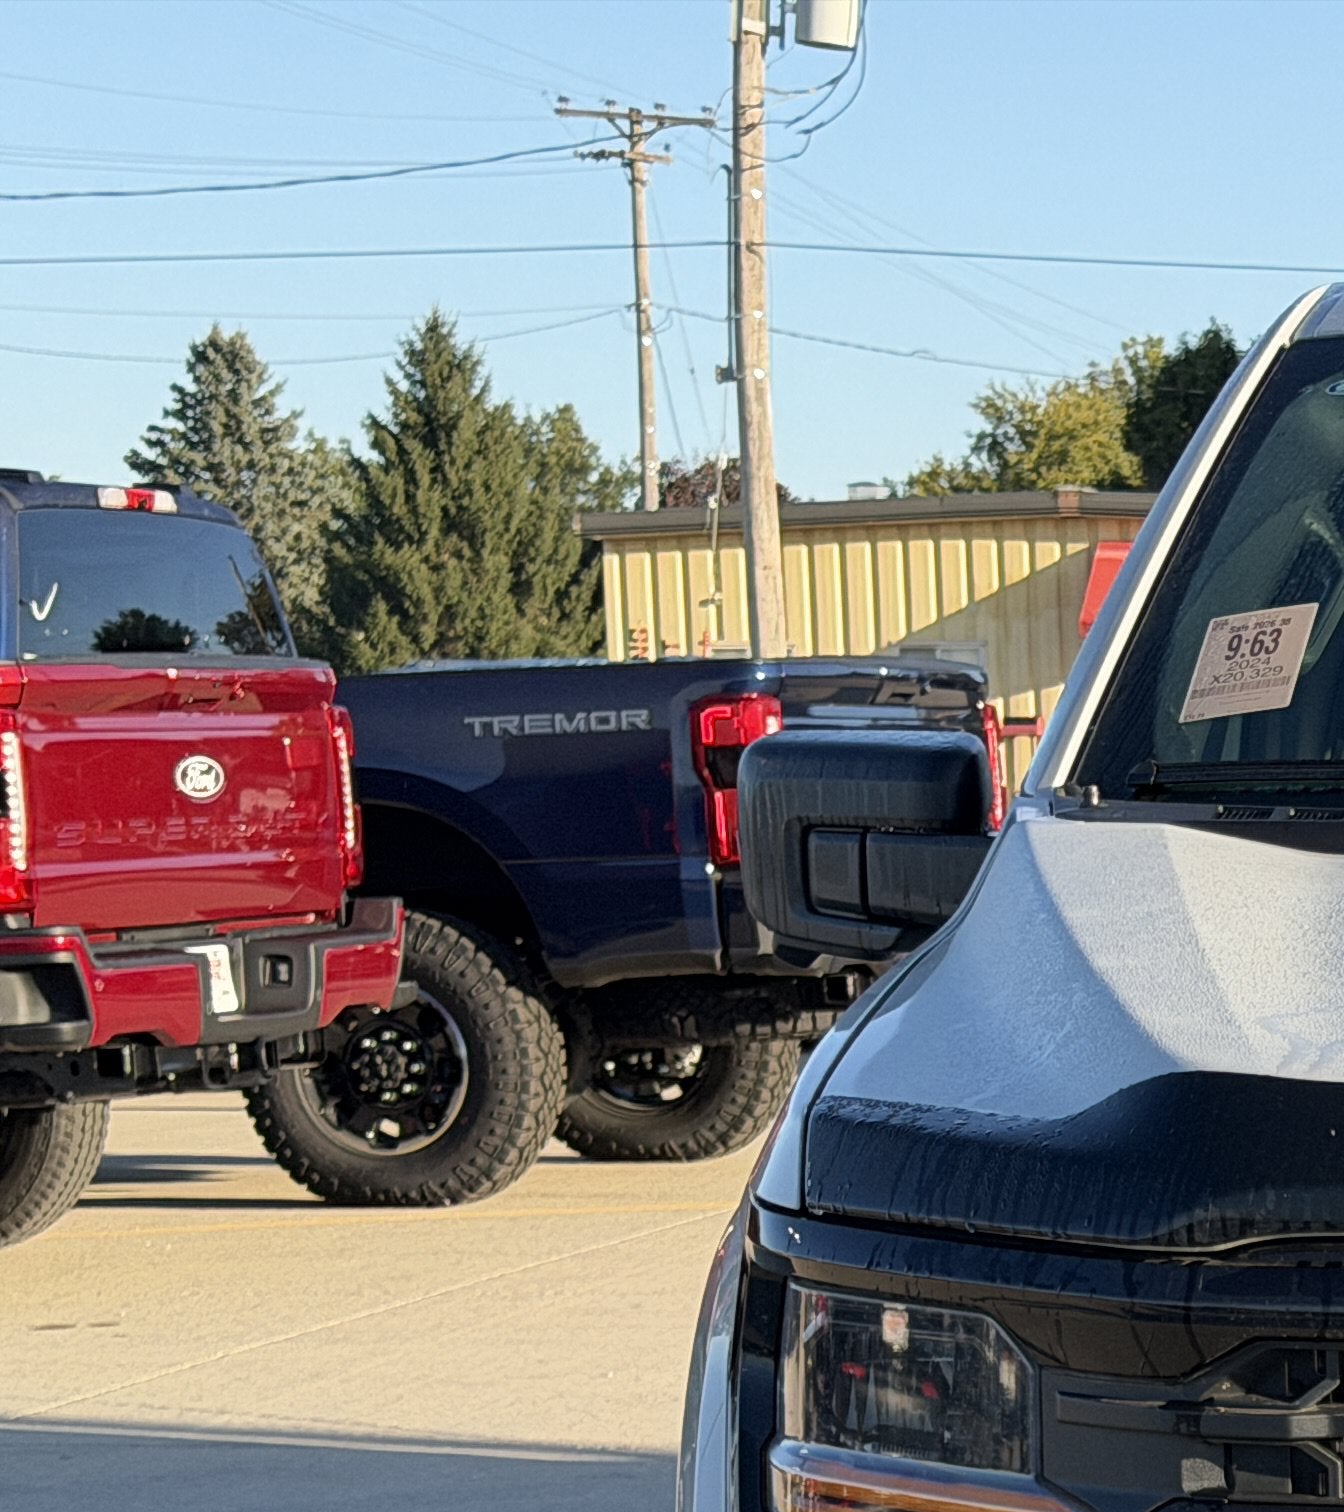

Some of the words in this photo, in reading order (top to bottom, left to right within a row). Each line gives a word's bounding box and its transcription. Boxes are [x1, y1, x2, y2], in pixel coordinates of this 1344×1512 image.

[1224, 628, 1282, 661] 9:63
[1227, 657, 1271, 672] 2024
[463, 709, 652, 738] TREMOR
